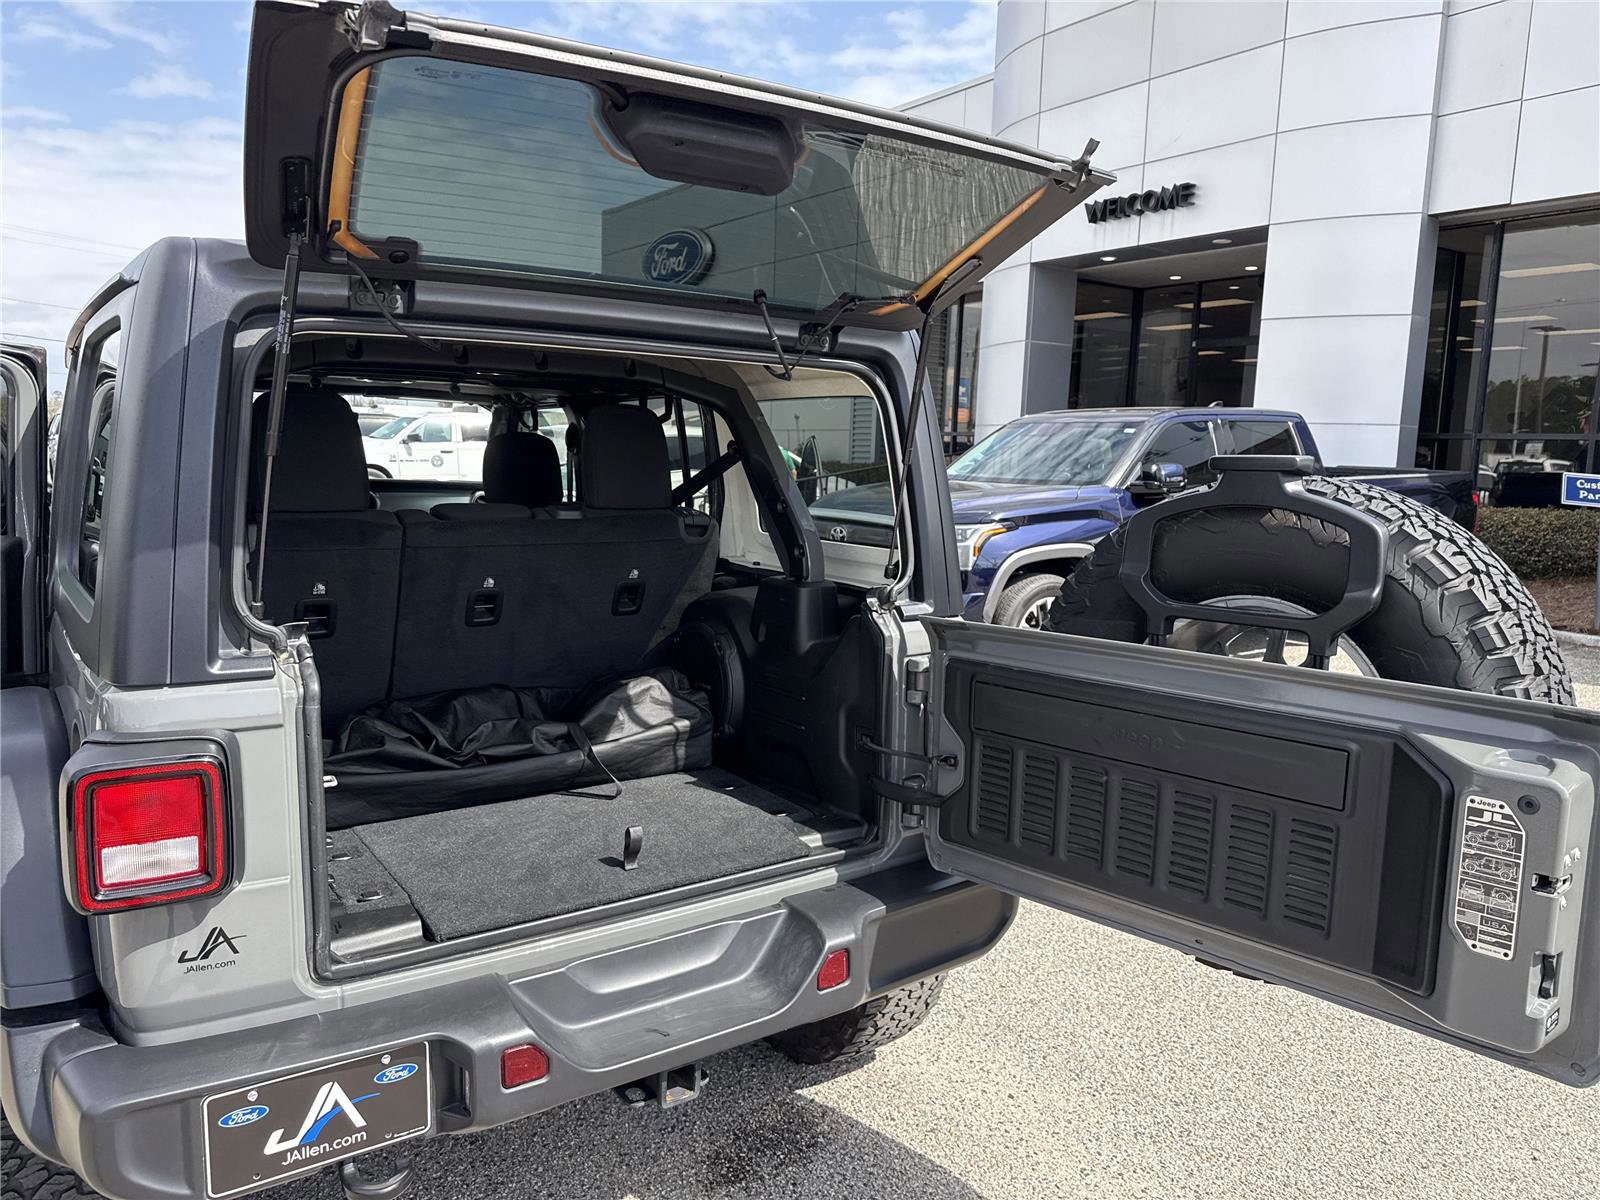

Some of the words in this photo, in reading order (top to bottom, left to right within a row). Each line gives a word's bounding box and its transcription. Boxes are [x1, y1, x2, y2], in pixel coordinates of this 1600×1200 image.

[1084, 182, 1197, 224] WELCOME
[651, 242, 688, 278] Ford
[1477, 799, 1497, 809] Jeep
[1482, 919, 1509, 932] USA
[184, 959, 236, 975] JAllen.com
[281, 1131, 367, 1166] JAllen.com
